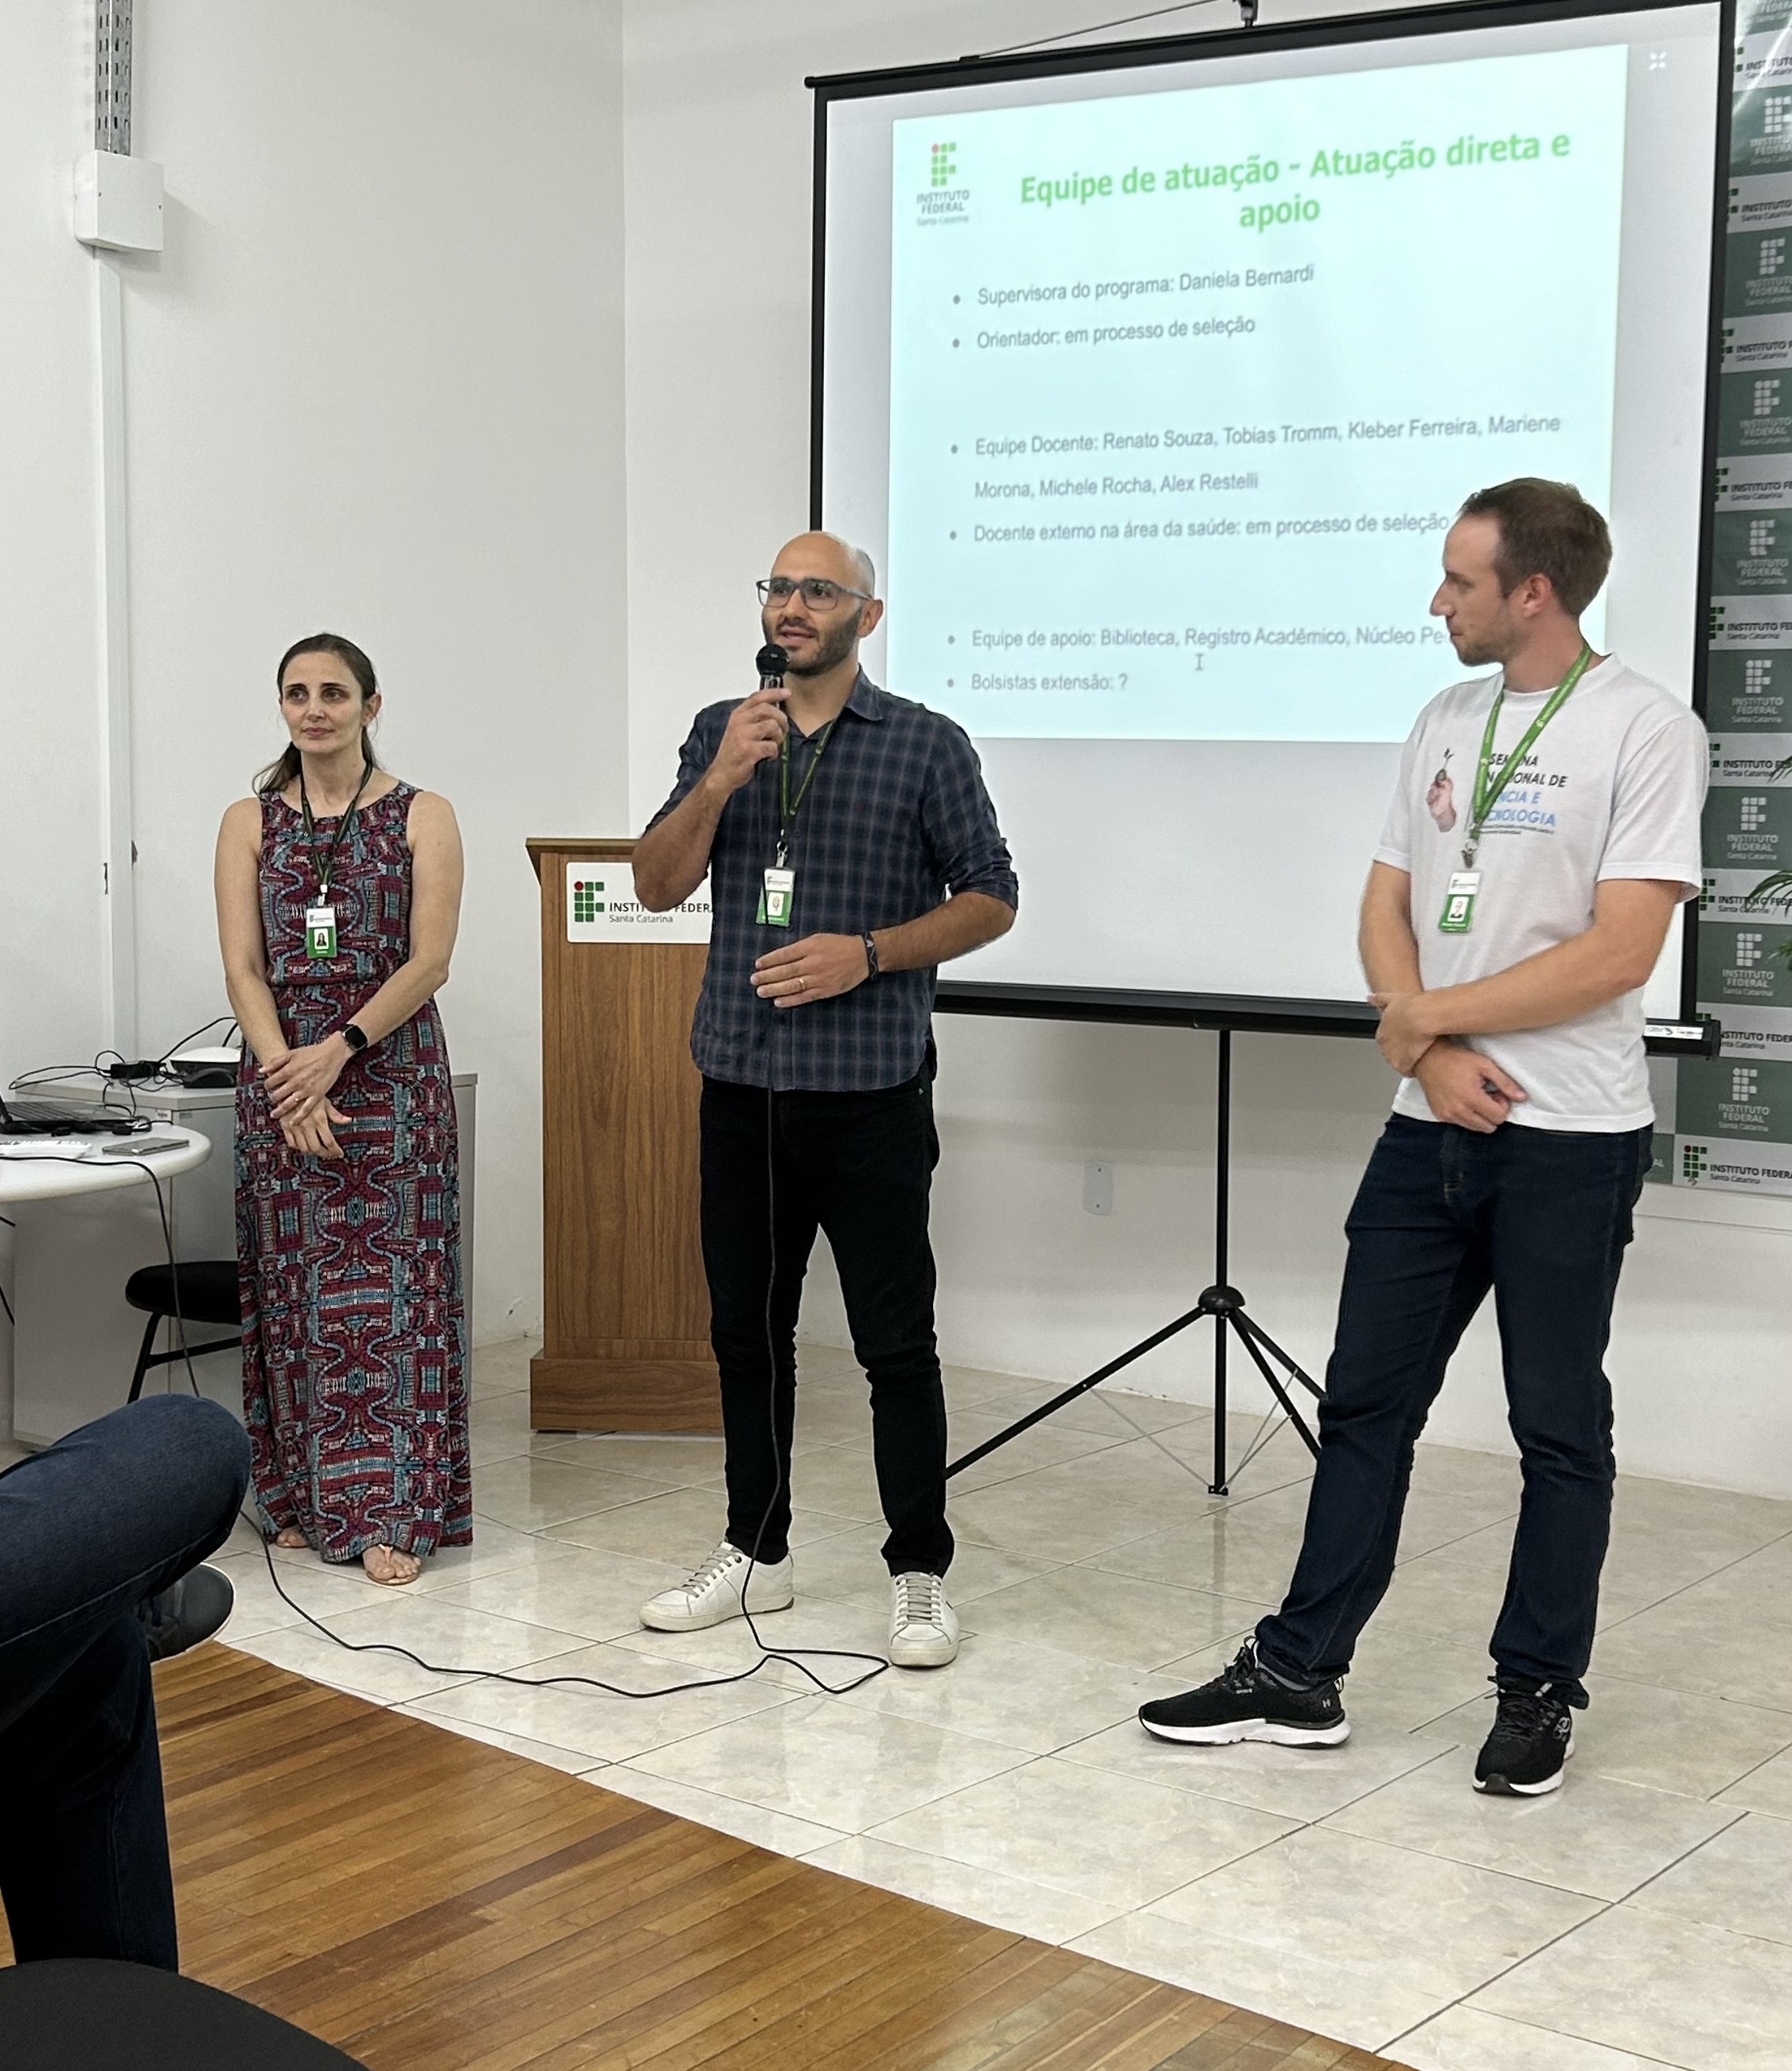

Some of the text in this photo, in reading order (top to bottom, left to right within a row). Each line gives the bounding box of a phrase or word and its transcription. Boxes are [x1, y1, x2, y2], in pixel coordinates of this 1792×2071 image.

[1021, 171, 1113, 208] Equipe
[1122, 166, 1156, 194] de
[1164, 154, 1280, 192] atuação
[1310, 139, 1436, 179] Atuação
[1446, 133, 1541, 166] direta
[1551, 134, 1571, 157] e
[916, 190, 970, 204] INSTITUTO
[922, 201, 965, 214] FEDERAL
[1240, 193, 1321, 233] apoio
[978, 264, 1314, 308] Supervisora do programa: Daniela Bernardi
[977, 315, 1255, 349] Orientador: em processo de seleção
[1736, 341, 1786, 353] INSTITUTO
[976, 415, 1561, 459] Equipe Docente: Renato Souza, Tobias Tromm, Kleber Ferreira, Mariene
[975, 472, 1258, 499] Morona, Michele Rocha, Alex Restelli
[1731, 482, 1782, 492] INSTITUTO
[974, 513, 1449, 541] Docente externo na área da saúde: em processo de seleção
[1736, 558, 1789, 568] INSTITUTO
[1741, 568, 1783, 576] FEDERAL
[973, 630, 1023, 651] Equipe
[1027, 631, 1046, 647] de
[1050, 630, 1095, 651] apoio:
[1101, 628, 1180, 648] Biblioteca,
[1185, 627, 1251, 650] Registro
[1254, 627, 1351, 647] Acadêmico,
[1356, 627, 1416, 645] Núcleo
[971, 673, 1128, 690] Bolsistas extensão: ?
[1732, 697, 1783, 705] INSTITUTO
[1489, 753, 1538, 766] SENA
[1548, 775, 1568, 787] DE
[1531, 791, 1540, 804] E
[1487, 809, 1556, 826] CNOLOGIA
[1728, 834, 1778, 843] INSTITUTO
[674, 902, 713, 913] FEDER
[609, 914, 673, 923] Santa Catarina
[1723, 969, 1774, 979] INSTITUTO
[1727, 978, 1769, 987] FEDERAL
[1721, 1031, 1763, 1041] STITUTO
[1719, 1104, 1770, 1115] INSTITUTO
[1723, 1112, 1765, 1123] FEDERAL
[1710, 1164, 1792, 1178] INSTITUTO FEDER
